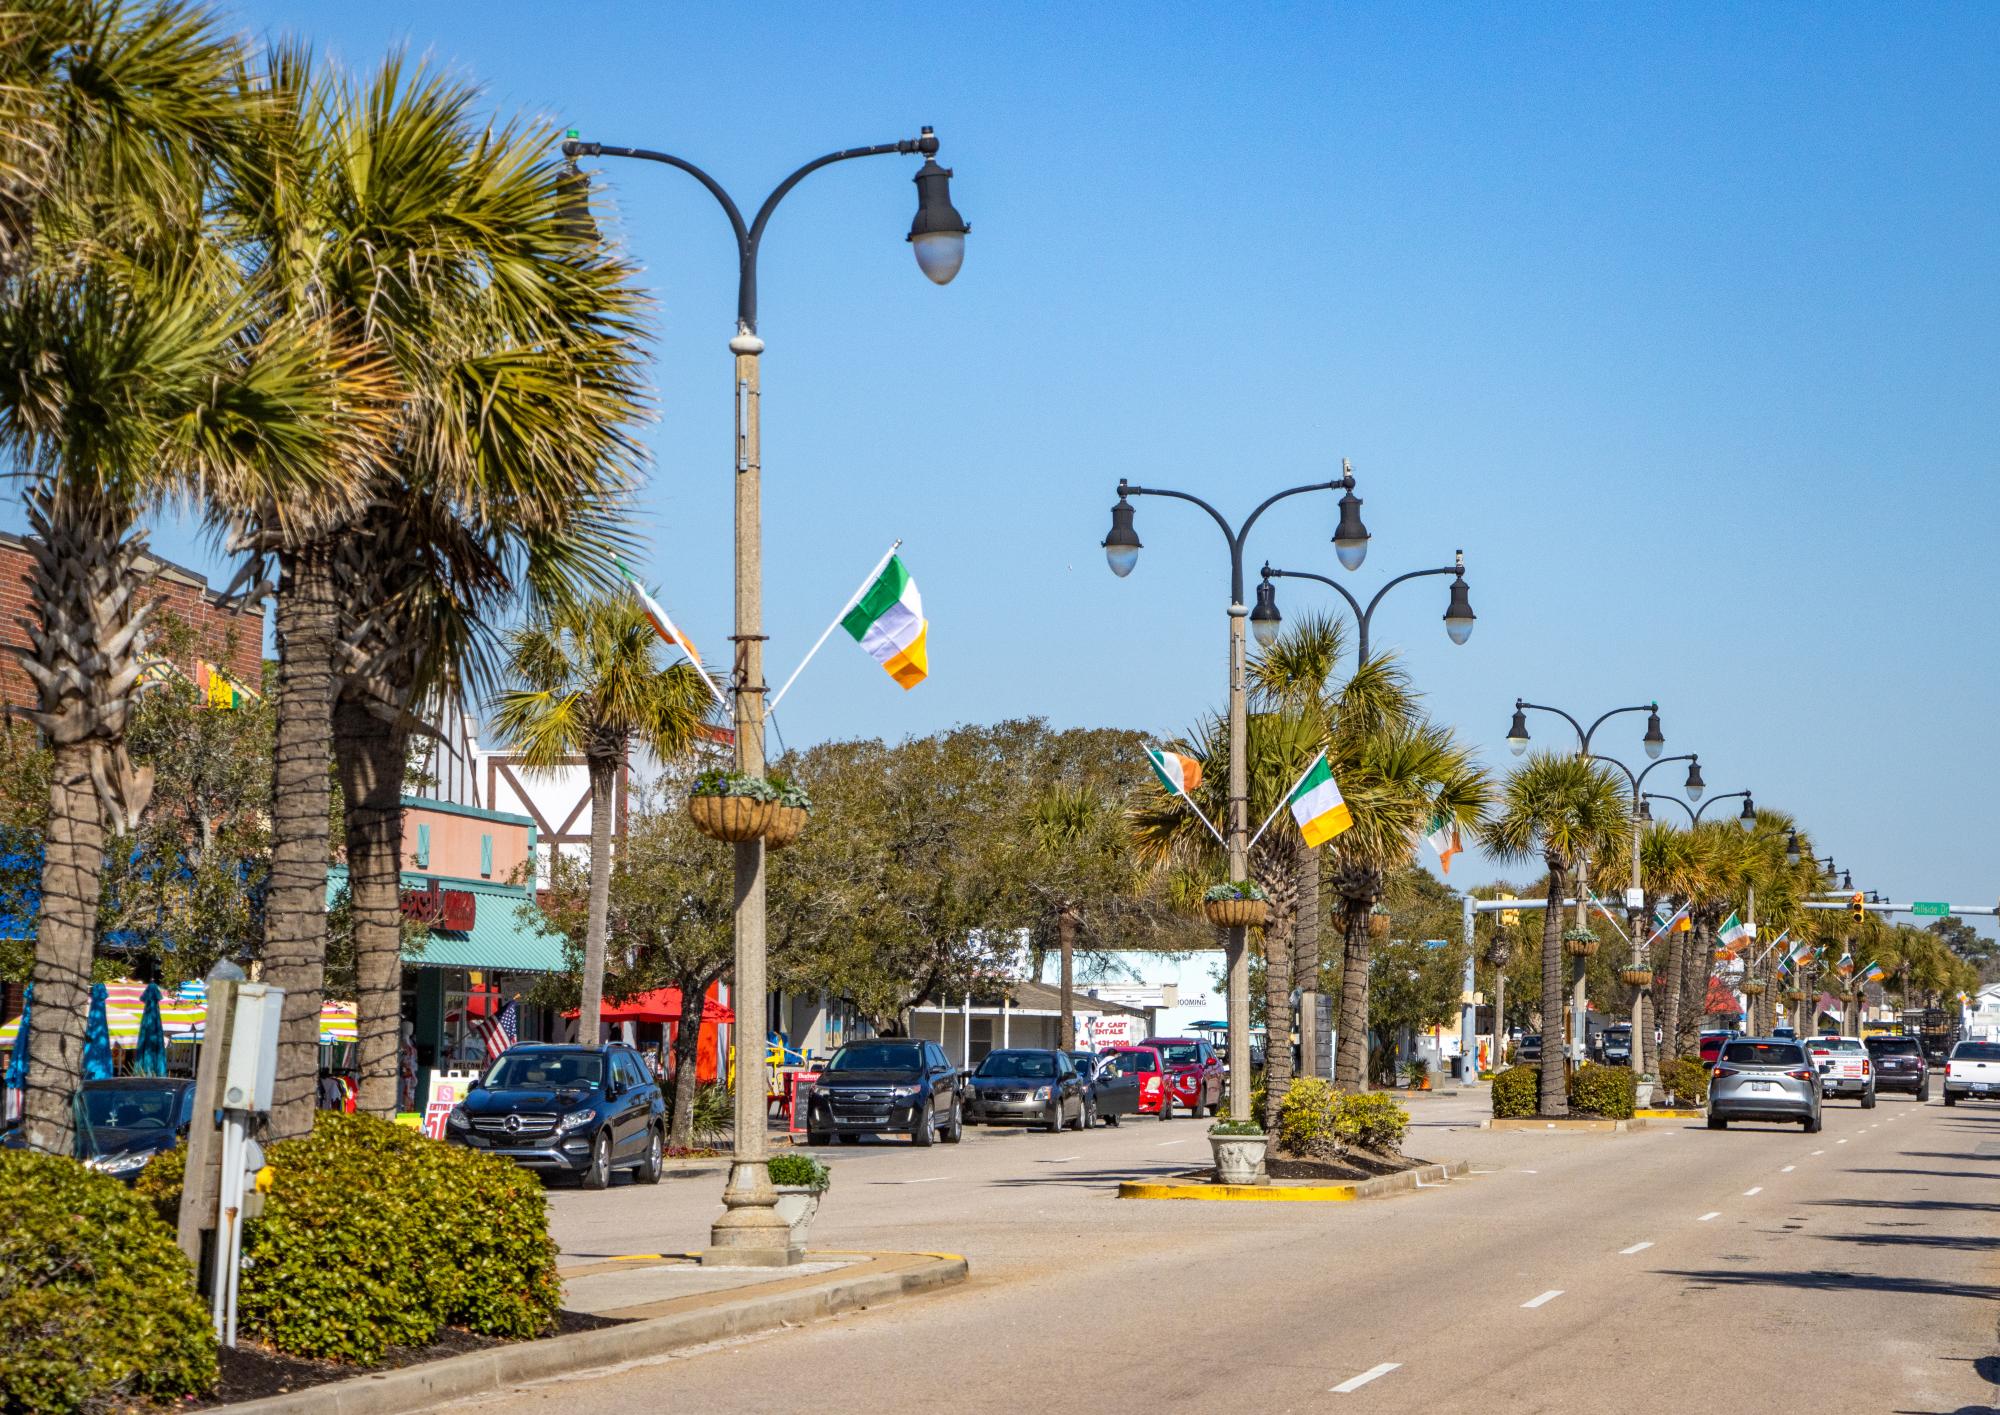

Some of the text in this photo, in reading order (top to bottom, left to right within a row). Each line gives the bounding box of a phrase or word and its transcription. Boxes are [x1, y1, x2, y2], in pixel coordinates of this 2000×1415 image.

[1914, 903, 1949, 914] Hillside Dr
[430, 1103, 451, 1111] ENTIRE
